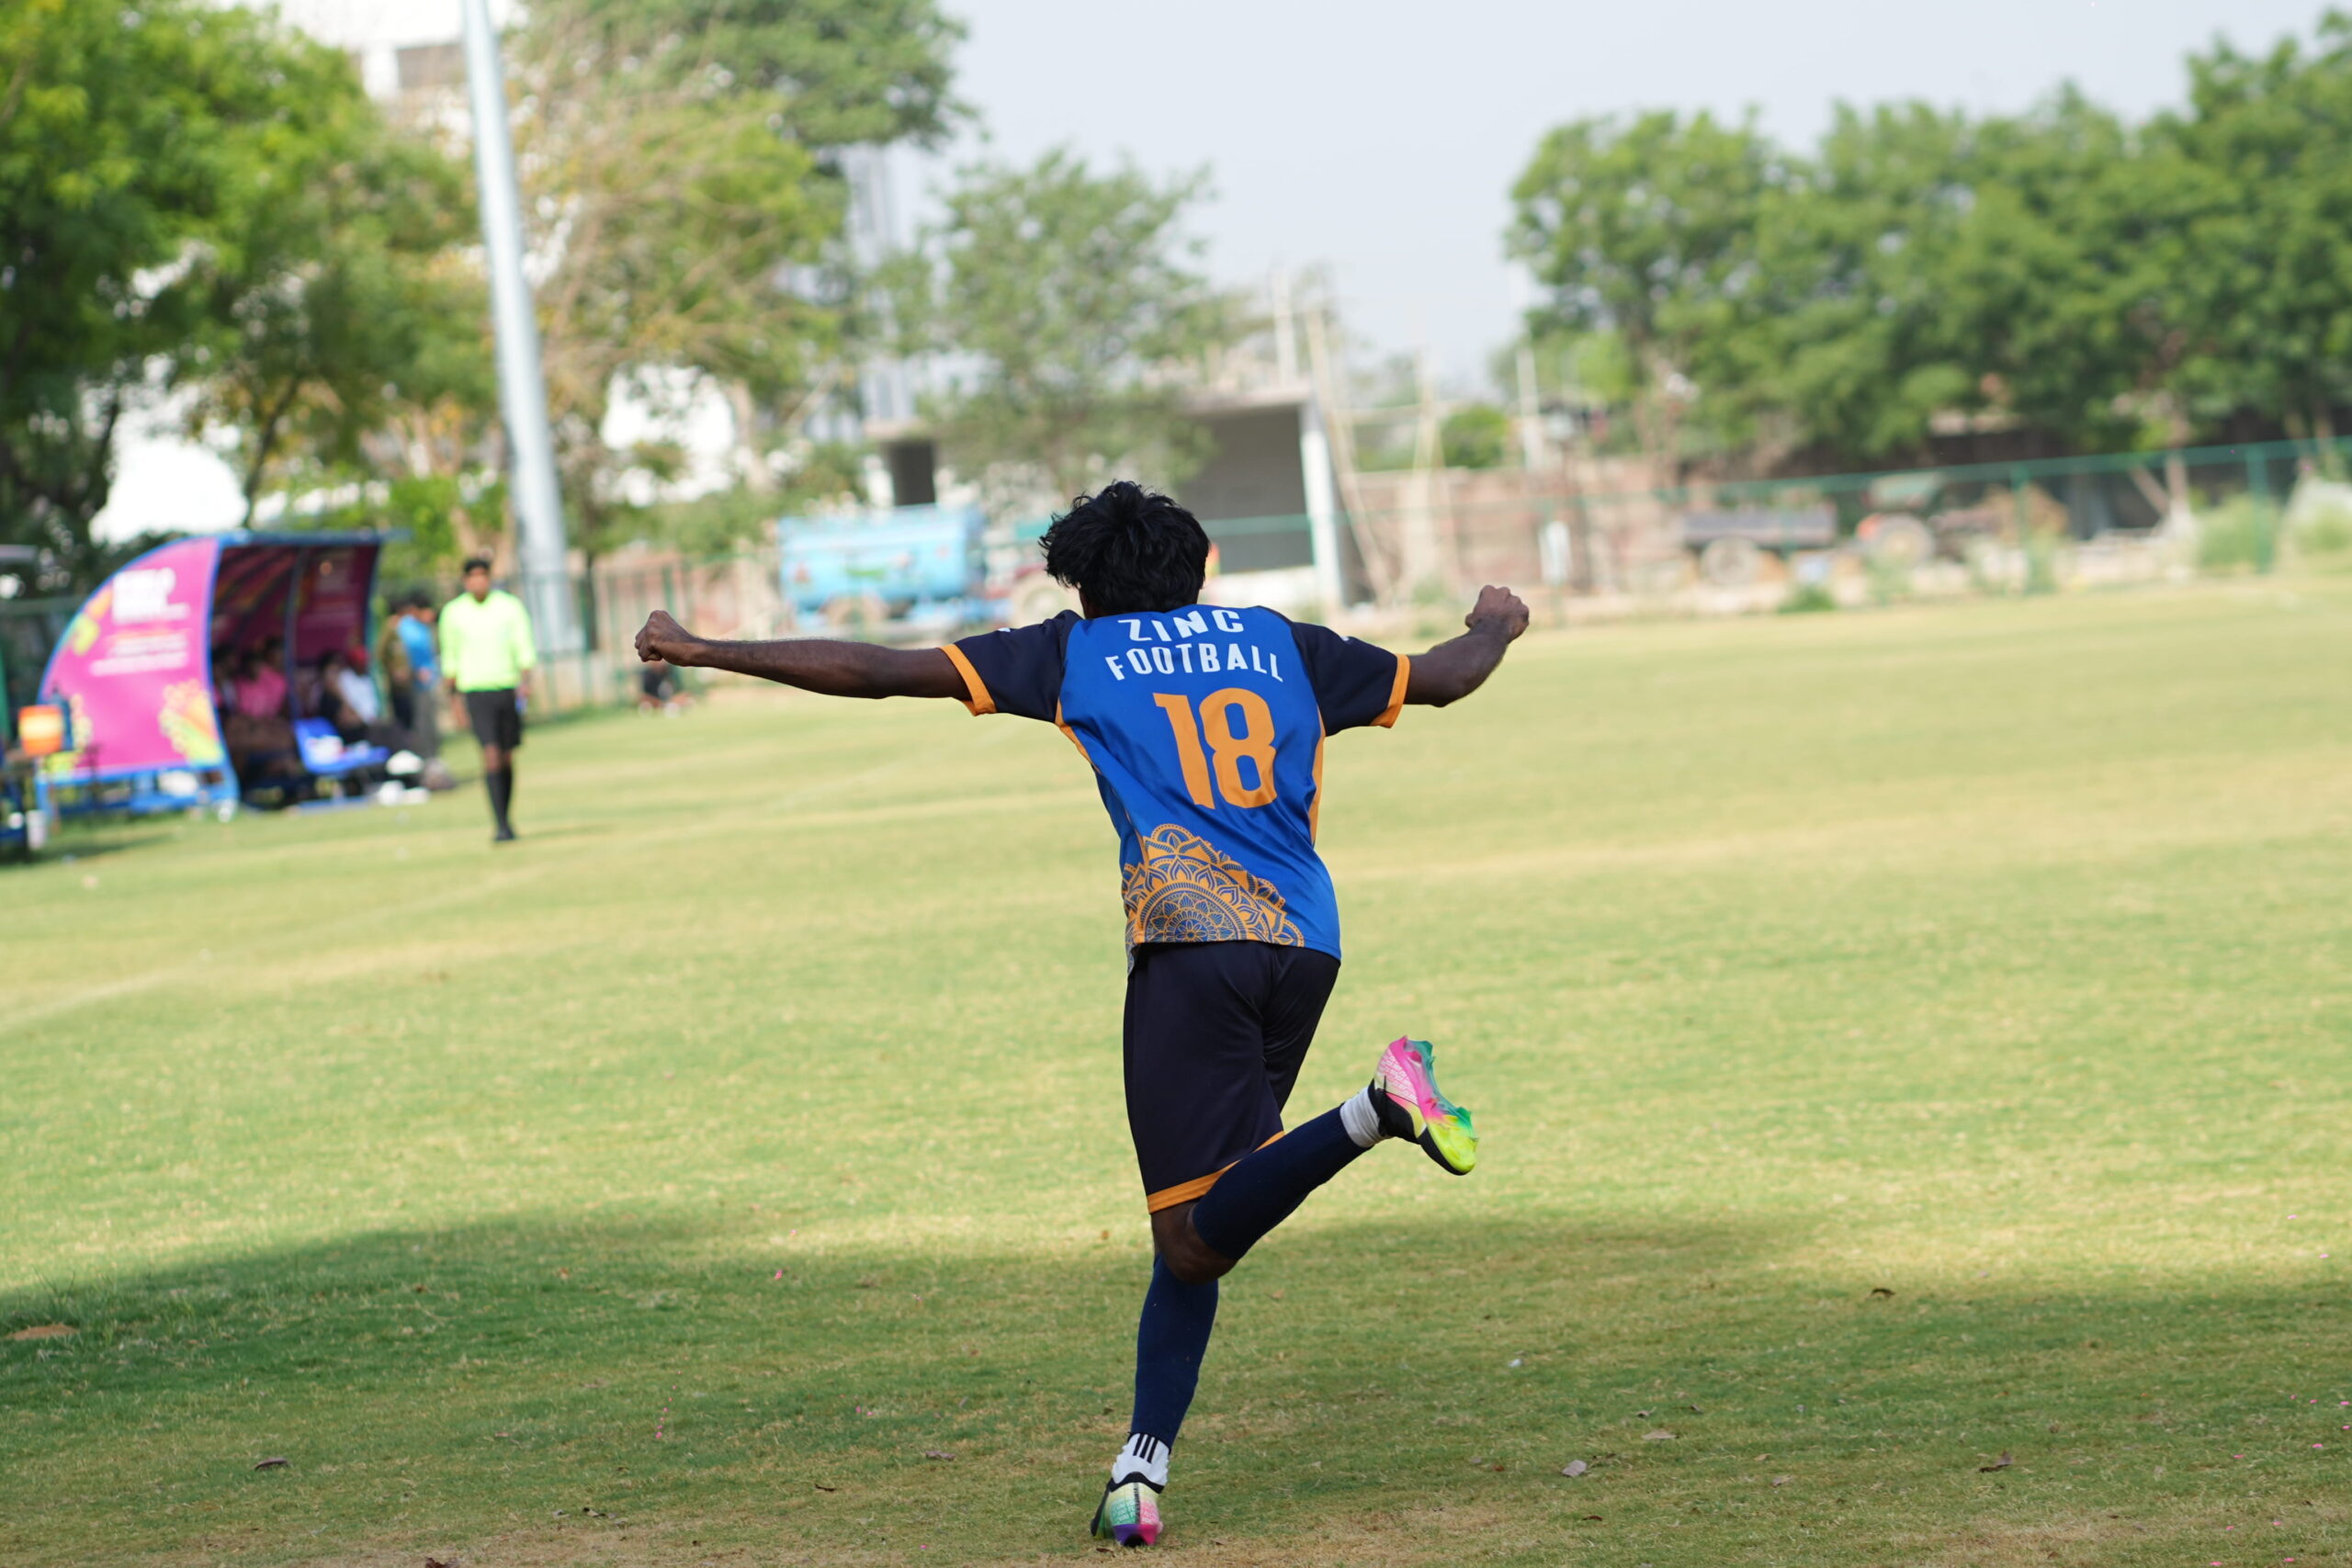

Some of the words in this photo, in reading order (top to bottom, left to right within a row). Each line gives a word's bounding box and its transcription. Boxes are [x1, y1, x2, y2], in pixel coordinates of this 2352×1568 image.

[1118, 609, 1244, 642] ZINC
[1105, 643, 1283, 682] FOOTBALL
[1152, 687, 1278, 809] 18
